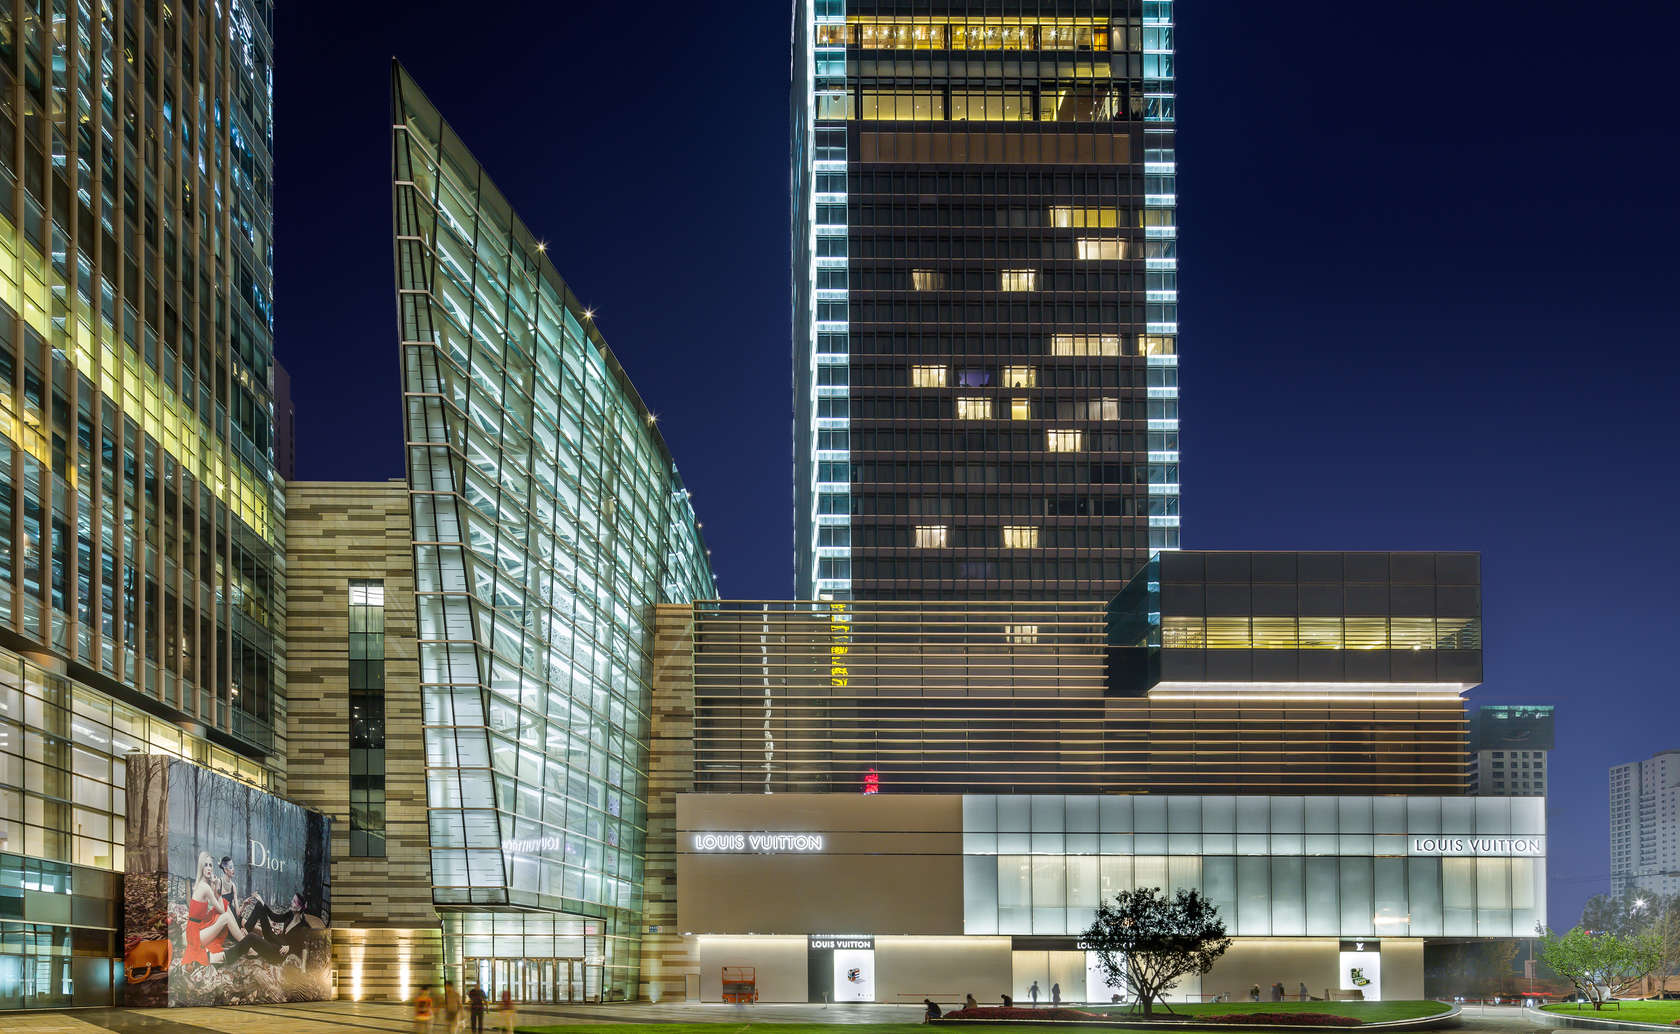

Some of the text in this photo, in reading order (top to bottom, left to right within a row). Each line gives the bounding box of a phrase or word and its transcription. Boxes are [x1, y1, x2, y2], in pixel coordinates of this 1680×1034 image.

[695, 834, 823, 850] LOUIS VUITTON
[1415, 838, 1541, 852] LOUIS VUITTON
[249, 839, 286, 873] Dior
[811, 940, 871, 948] LOUIS VUITTON
